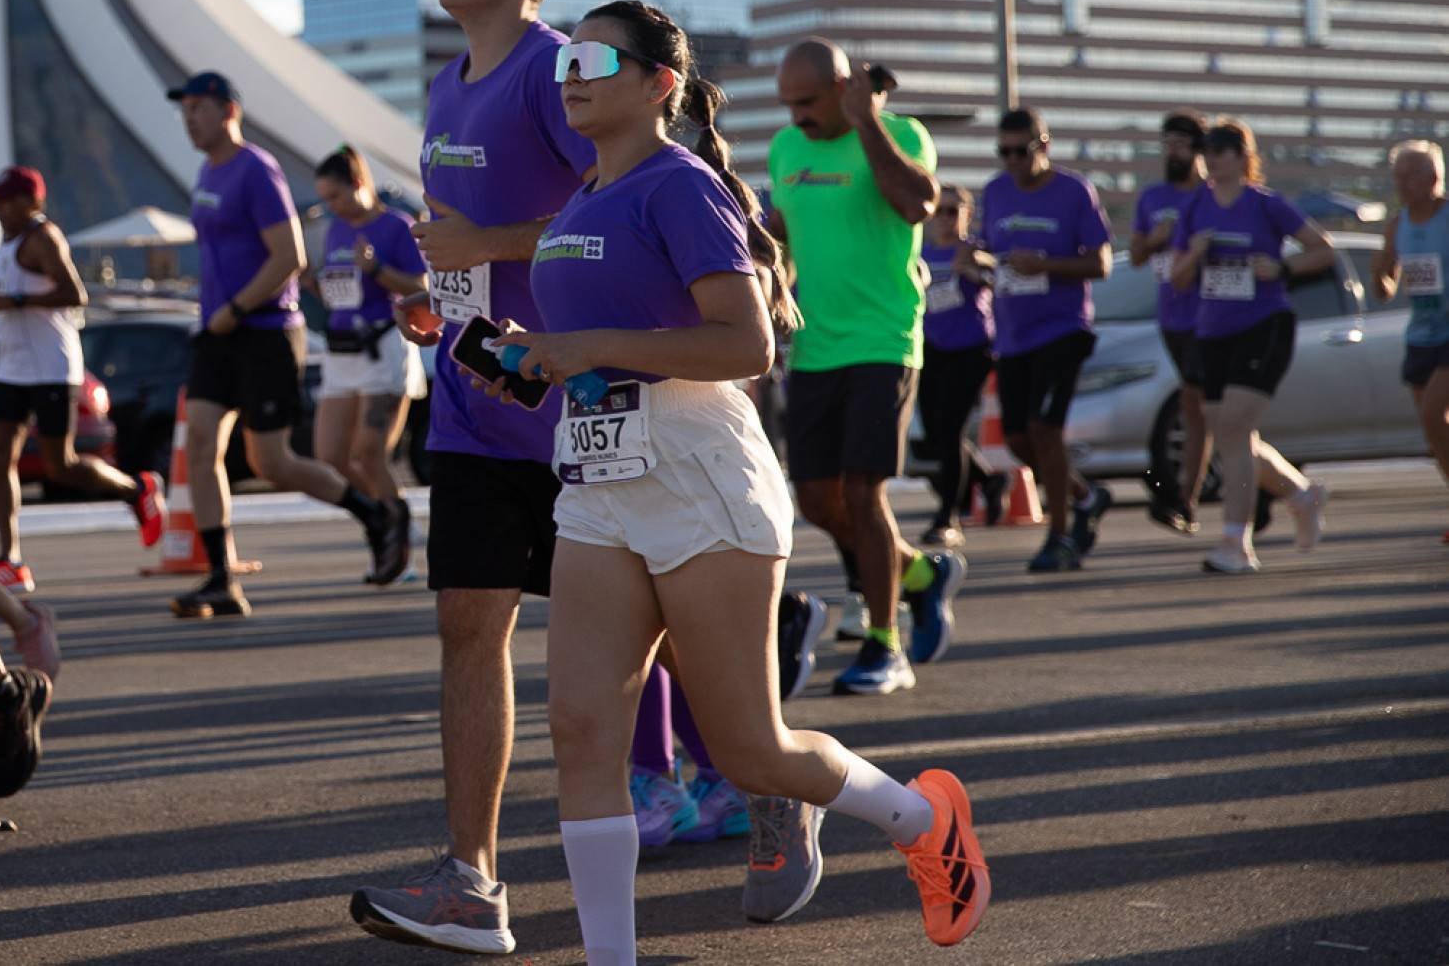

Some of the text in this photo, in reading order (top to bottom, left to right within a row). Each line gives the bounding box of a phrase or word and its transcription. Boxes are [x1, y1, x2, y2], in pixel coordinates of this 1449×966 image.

[587, 239, 601, 248] 20
[585, 248, 600, 257] 26
[570, 416, 627, 454] 5057
